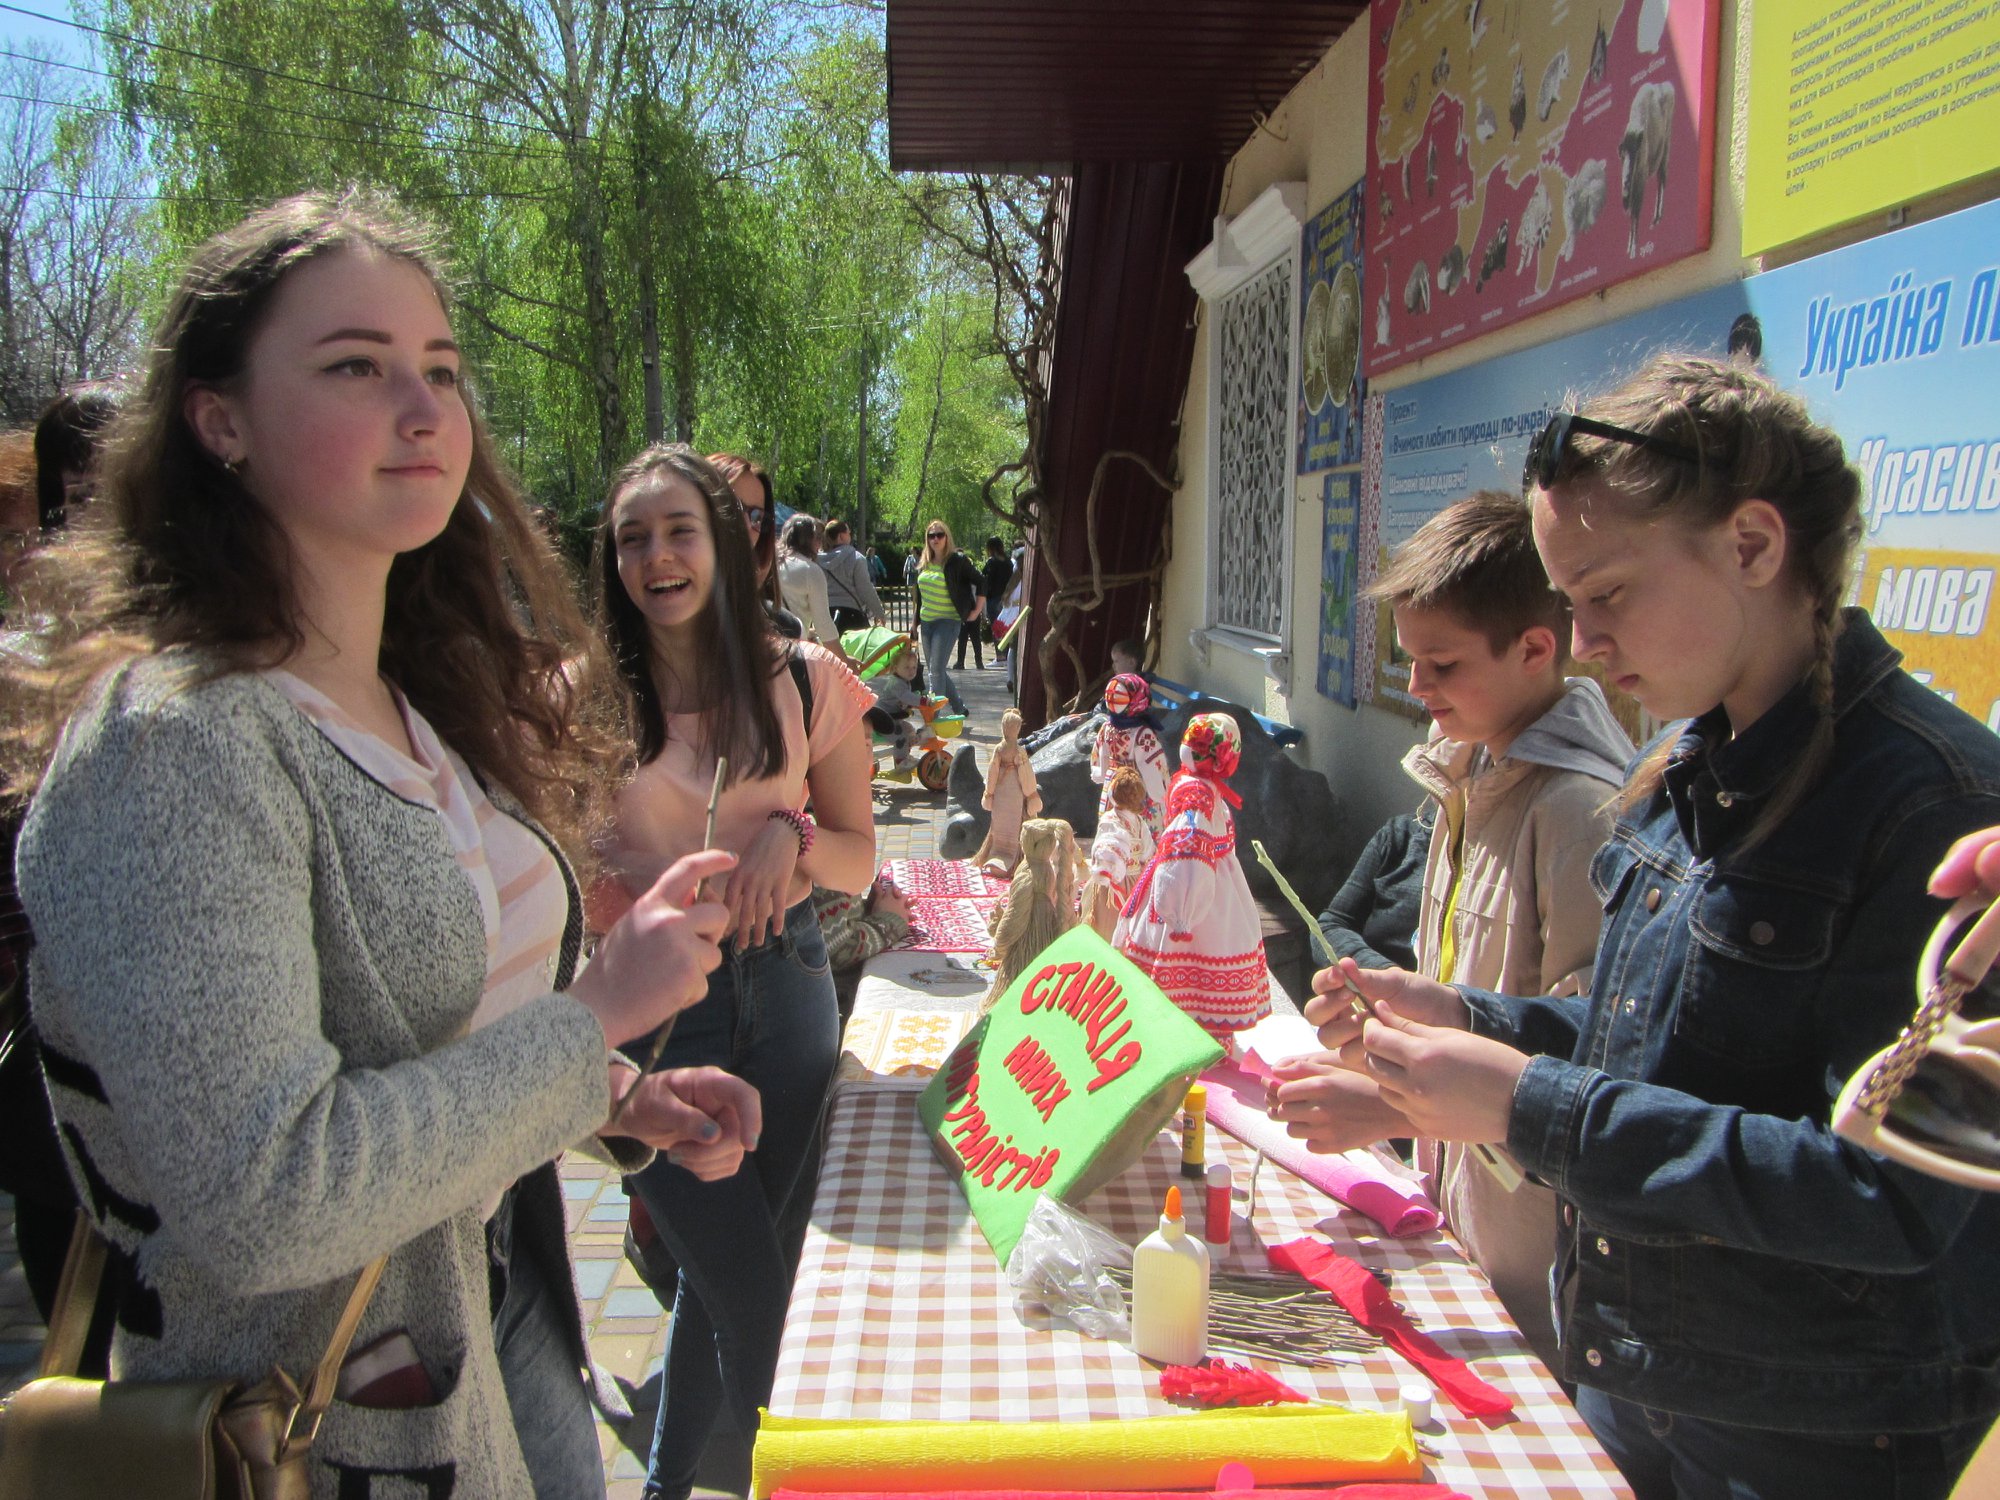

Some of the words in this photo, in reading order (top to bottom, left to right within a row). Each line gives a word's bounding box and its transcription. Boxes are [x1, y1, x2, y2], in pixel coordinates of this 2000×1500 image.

[1800, 271, 1952, 391] Україна
[1425, 424, 1456, 449] любити
[1458, 420, 1498, 447] природу
[1871, 568, 1993, 636] мова
[1003, 1035, 1072, 1124] ЮНИХ
